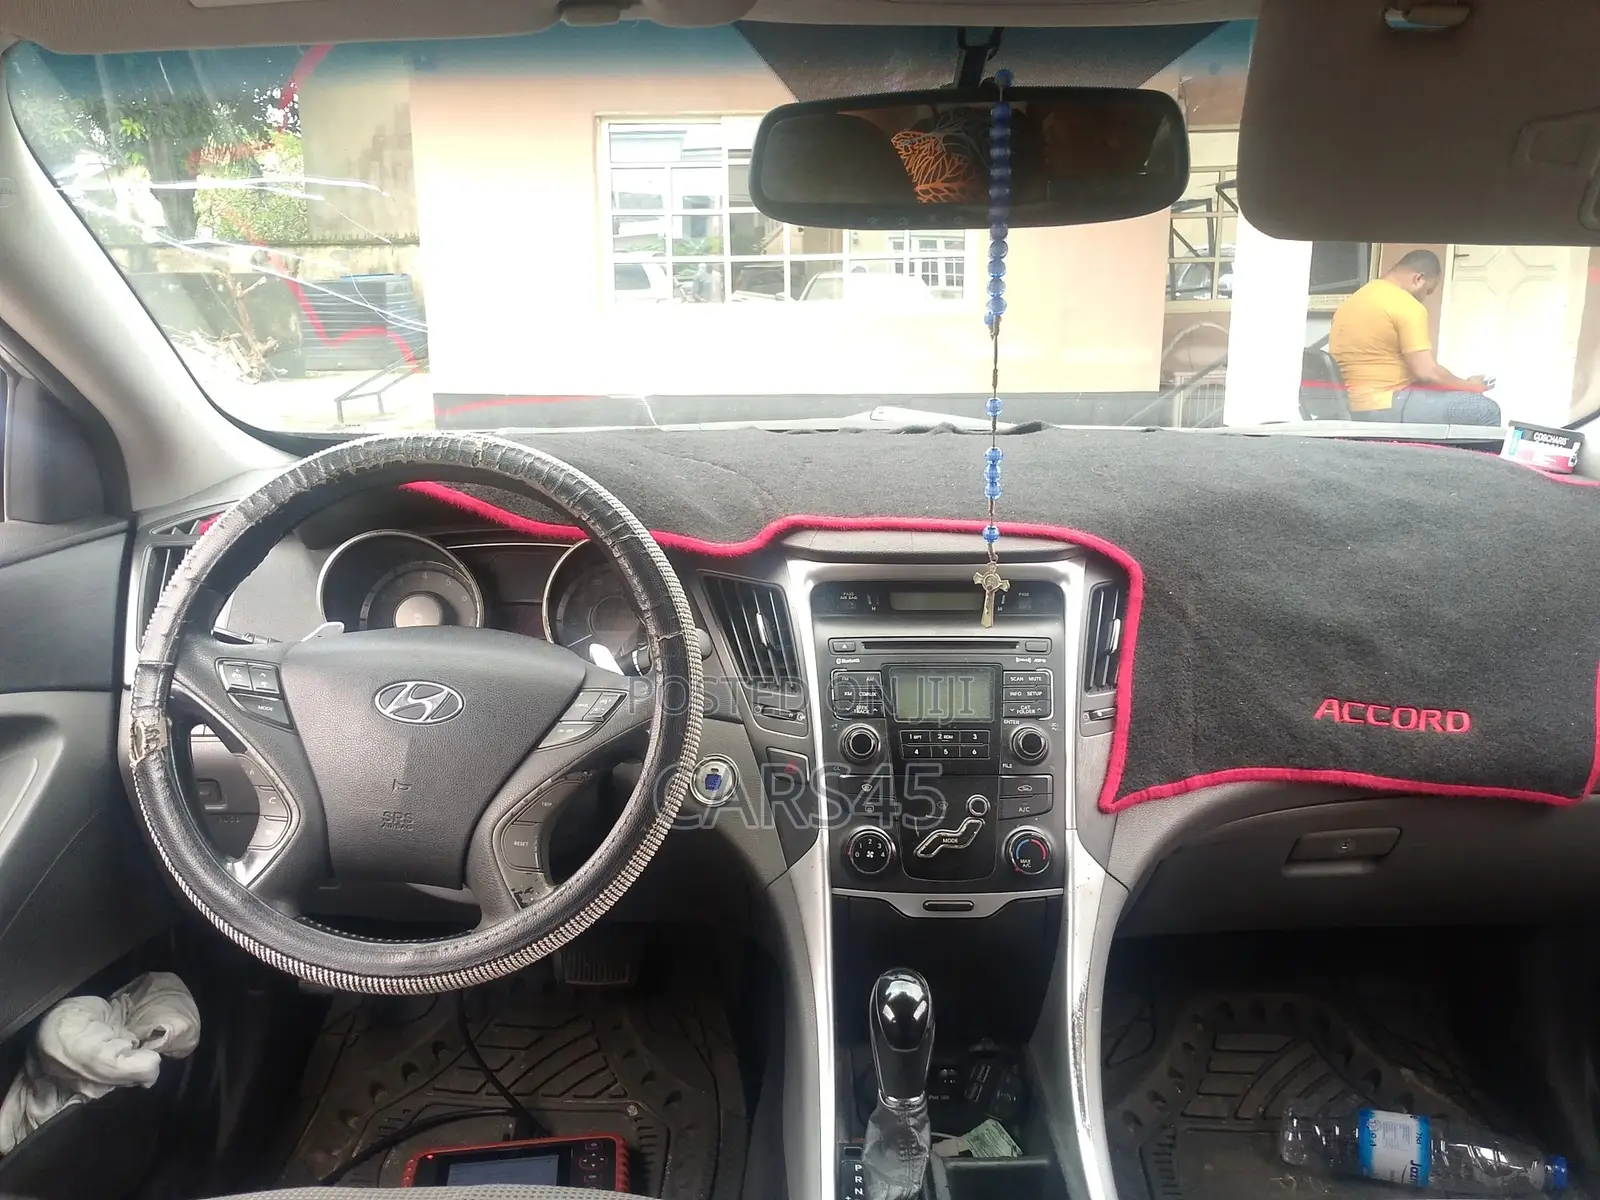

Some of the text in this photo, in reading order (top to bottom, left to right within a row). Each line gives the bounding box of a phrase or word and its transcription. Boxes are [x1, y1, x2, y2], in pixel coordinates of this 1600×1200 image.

[1533, 431, 1567, 446] COSCHARIS
[1313, 696, 1472, 734] ACCORD
[854, 1164, 863, 1172] P
[854, 1175, 863, 1184] R
[854, 1187, 864, 1196] N
